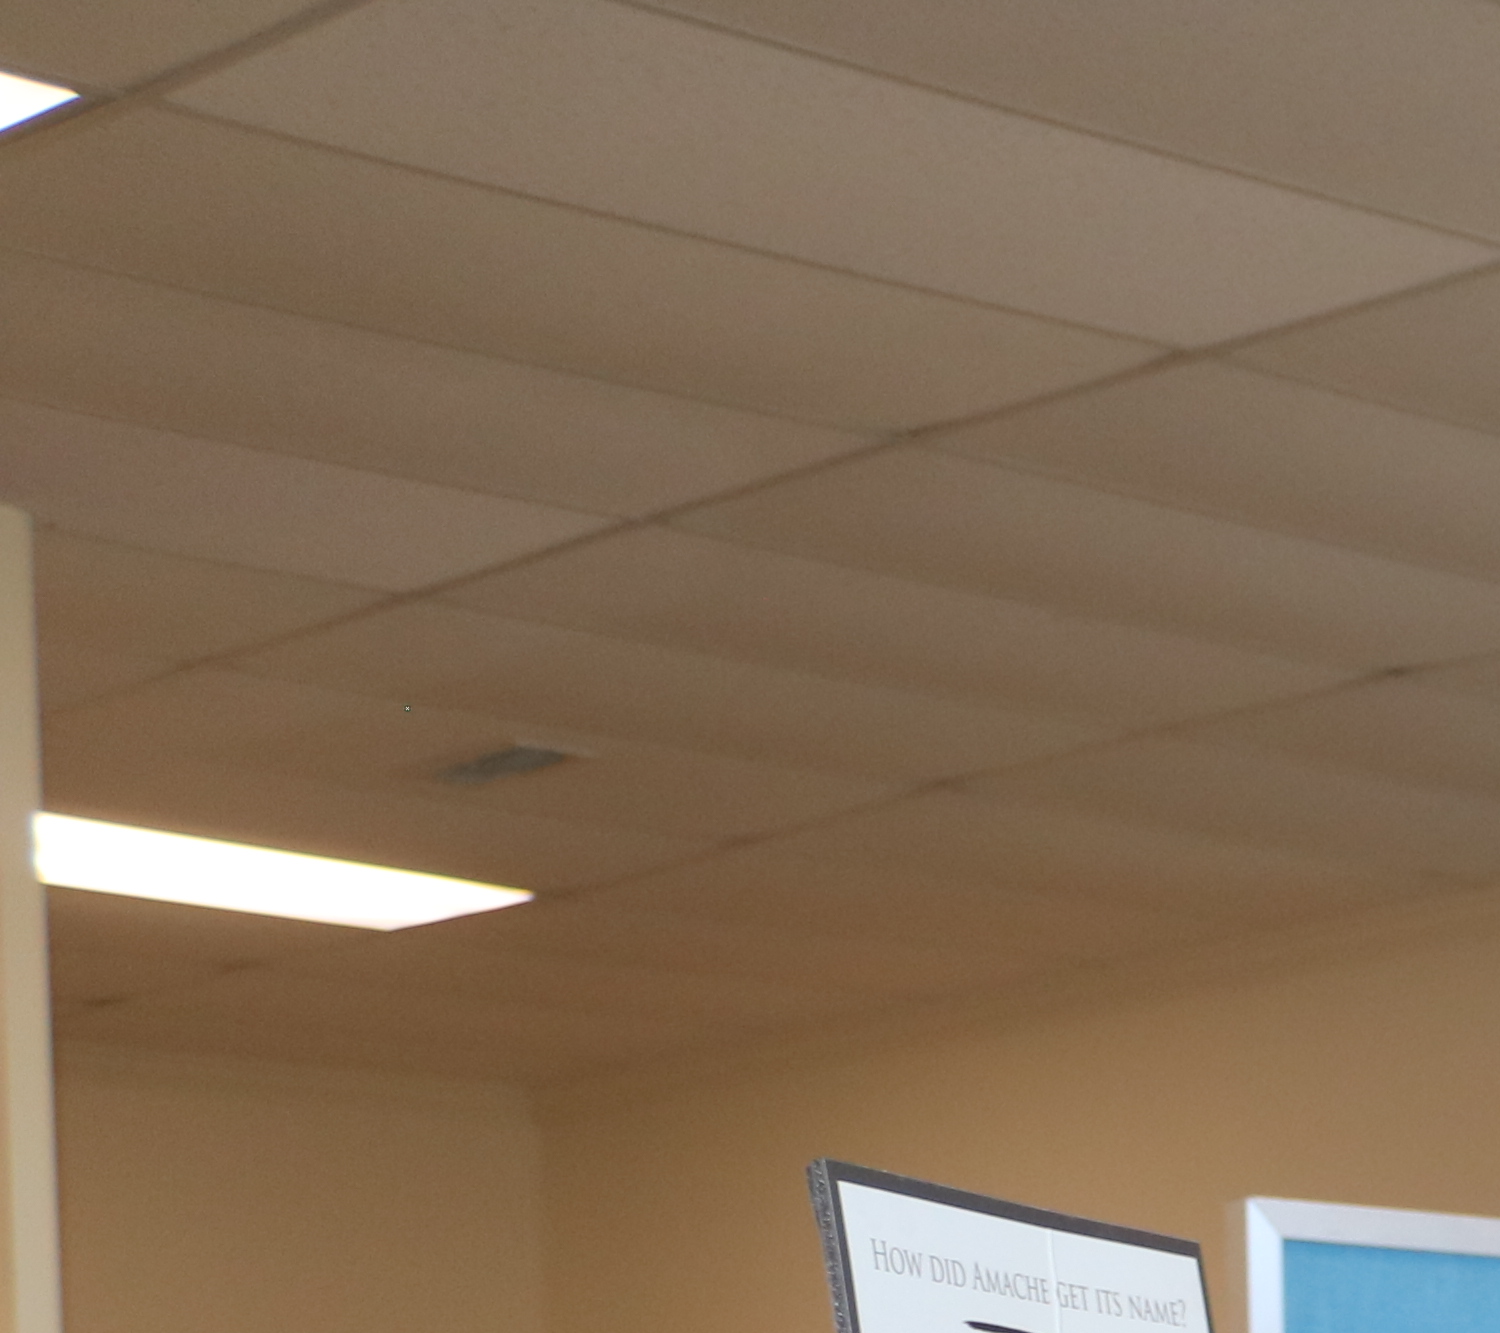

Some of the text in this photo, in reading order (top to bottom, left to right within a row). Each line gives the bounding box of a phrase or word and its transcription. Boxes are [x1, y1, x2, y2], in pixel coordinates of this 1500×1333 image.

[869, 1237, 1186, 1327] HOW DID AMACHE GET ITS NAME?
